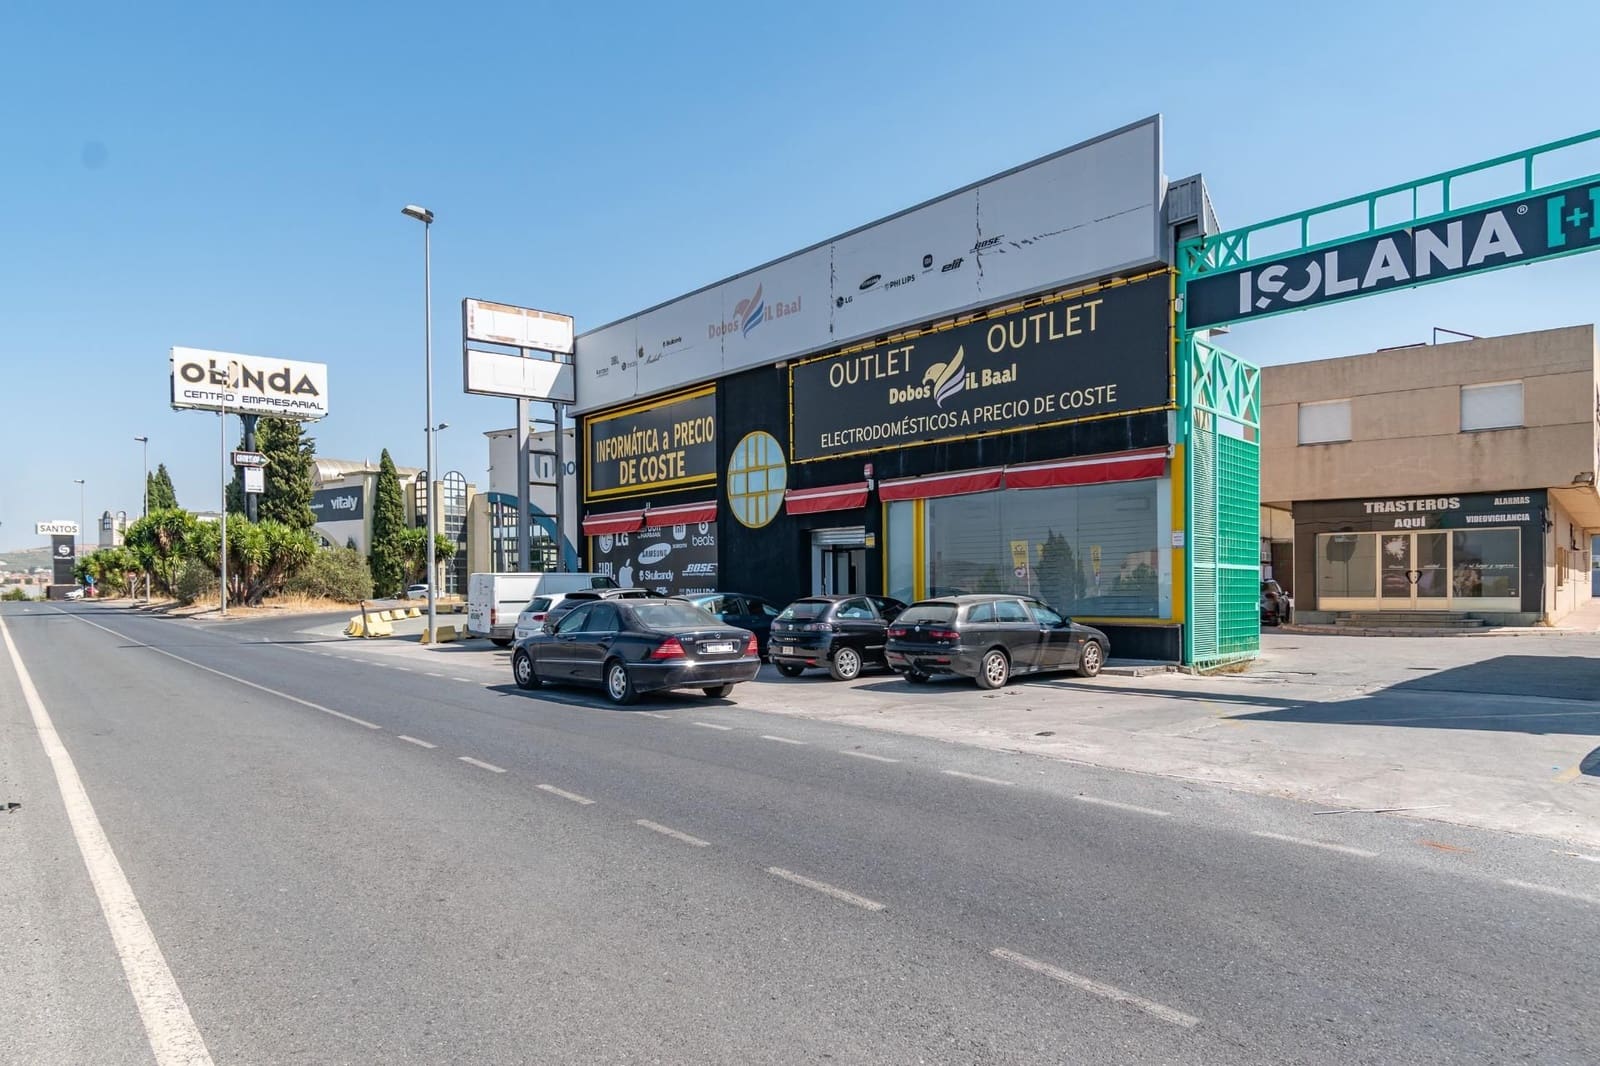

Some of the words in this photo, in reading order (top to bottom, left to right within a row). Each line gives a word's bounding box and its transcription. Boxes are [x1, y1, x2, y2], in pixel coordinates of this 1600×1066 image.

[776, 295, 801, 318] Baal
[845, 295, 853, 304] LG
[987, 298, 1103, 353] OUTLET
[829, 345, 915, 388] OUTLET
[889, 382, 931, 405] Dobos
[981, 363, 1017, 385] Baal
[184, 390, 234, 402] CENTRO
[242, 395, 324, 410] EMPRESARIAL
[821, 411, 958, 449] ELECTRODOMÉSTICOS
[960, 410, 970, 426] A
[974, 399, 1029, 423] PRECIO
[1034, 396, 1055, 415] DE
[1059, 384, 1117, 410] COSTE
[596, 426, 659, 463] INFORMÁTICA
[662, 431, 670, 450] a
[674, 416, 714, 448] PRECIO
[619, 459, 636, 485] DE
[639, 451, 685, 482] COSTE
[330, 495, 358, 511] vitaly
[1364, 497, 1460, 513] TRASTEROS
[1494, 496, 1530, 505] ALARMAS
[1394, 516, 1426, 528] AQUÍ
[1465, 513, 1530, 523] VIDEOVIGILANCIA
[40, 525, 77, 533] SANTOS
[615, 532, 629, 546] LG
[691, 534, 715, 546] beats
[686, 563, 717, 572] BOSE
